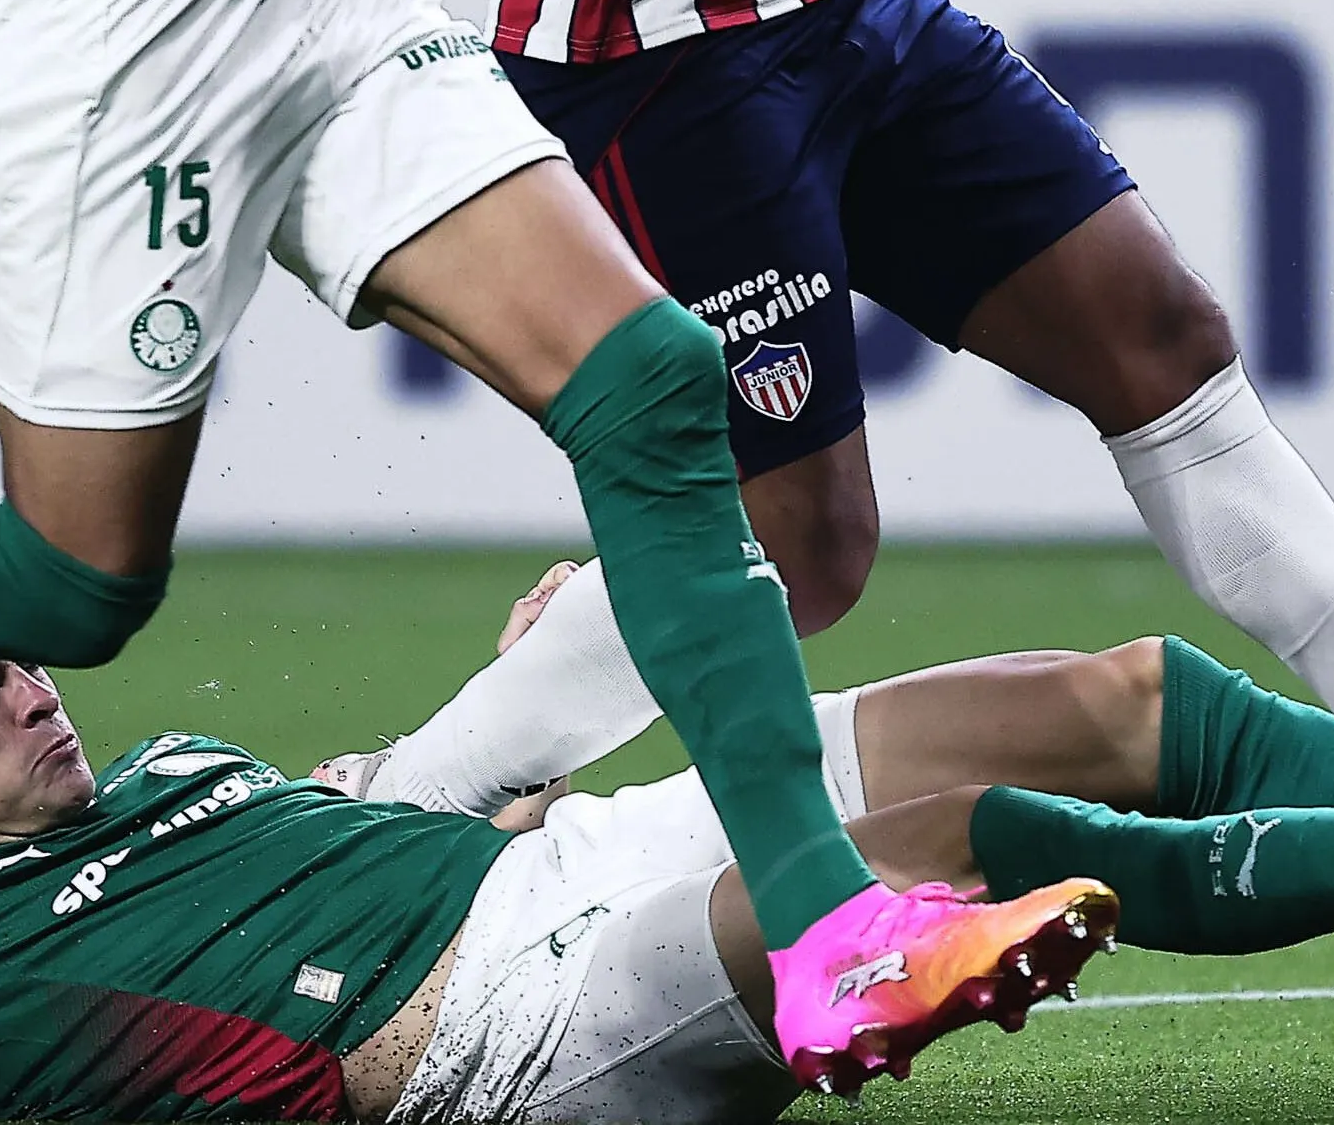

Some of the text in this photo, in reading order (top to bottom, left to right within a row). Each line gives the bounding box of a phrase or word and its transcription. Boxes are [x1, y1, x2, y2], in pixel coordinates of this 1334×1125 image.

[145, 160, 210, 251] 15
[689, 269, 780, 318] expreso
[750, 362, 799, 389] JUNIOR
